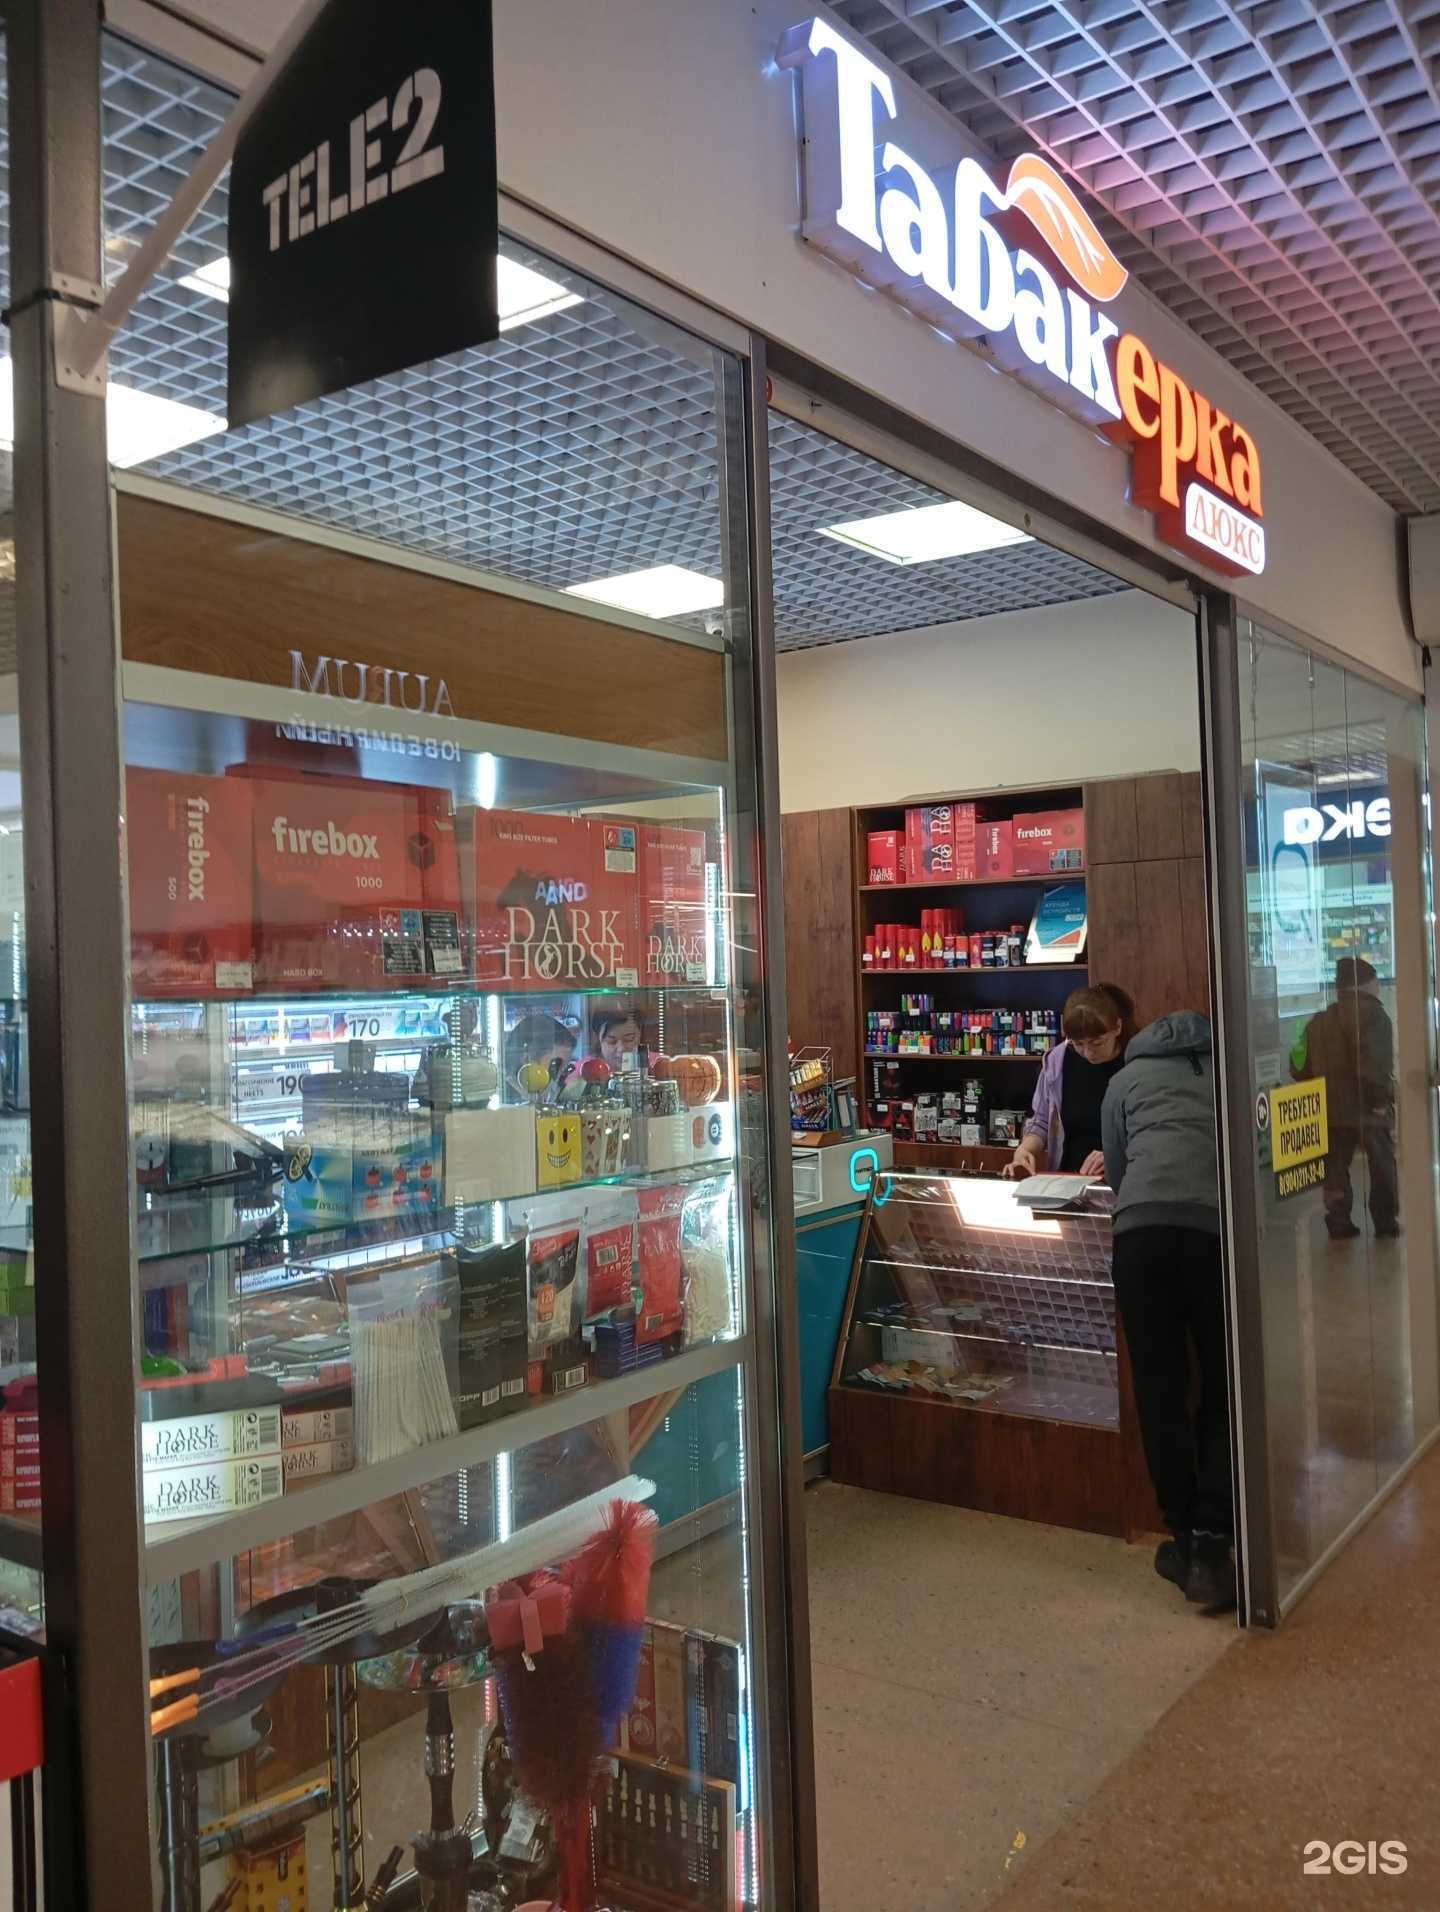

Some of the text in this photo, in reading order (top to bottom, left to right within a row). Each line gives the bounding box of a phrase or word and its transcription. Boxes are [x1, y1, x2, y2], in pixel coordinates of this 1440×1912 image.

[263, 67, 445, 252] TELE2
[810, 16, 1263, 517] Табакерка
[1191, 488, 1263, 568] ЛЮКС
[187, 794, 209, 901] firebox
[271, 815, 381, 860] firebox
[1016, 826, 1053, 840] firebox
[355, 874, 384, 890] 1000
[505, 907, 625, 945] DARK
[503, 943, 626, 981] HORSE
[647, 935, 704, 955] DARK
[348, 1018, 381, 1037] 170
[1278, 1091, 1321, 1127] ТРЕБУЕТСЯ
[1280, 1121, 1321, 1157] ПРОДАВЕЦ
[155, 1437, 221, 1457] HORSE
[157, 1423, 219, 1445] DARK
[157, 1488, 222, 1508] HORSE
[159, 1474, 220, 1497] DARK
